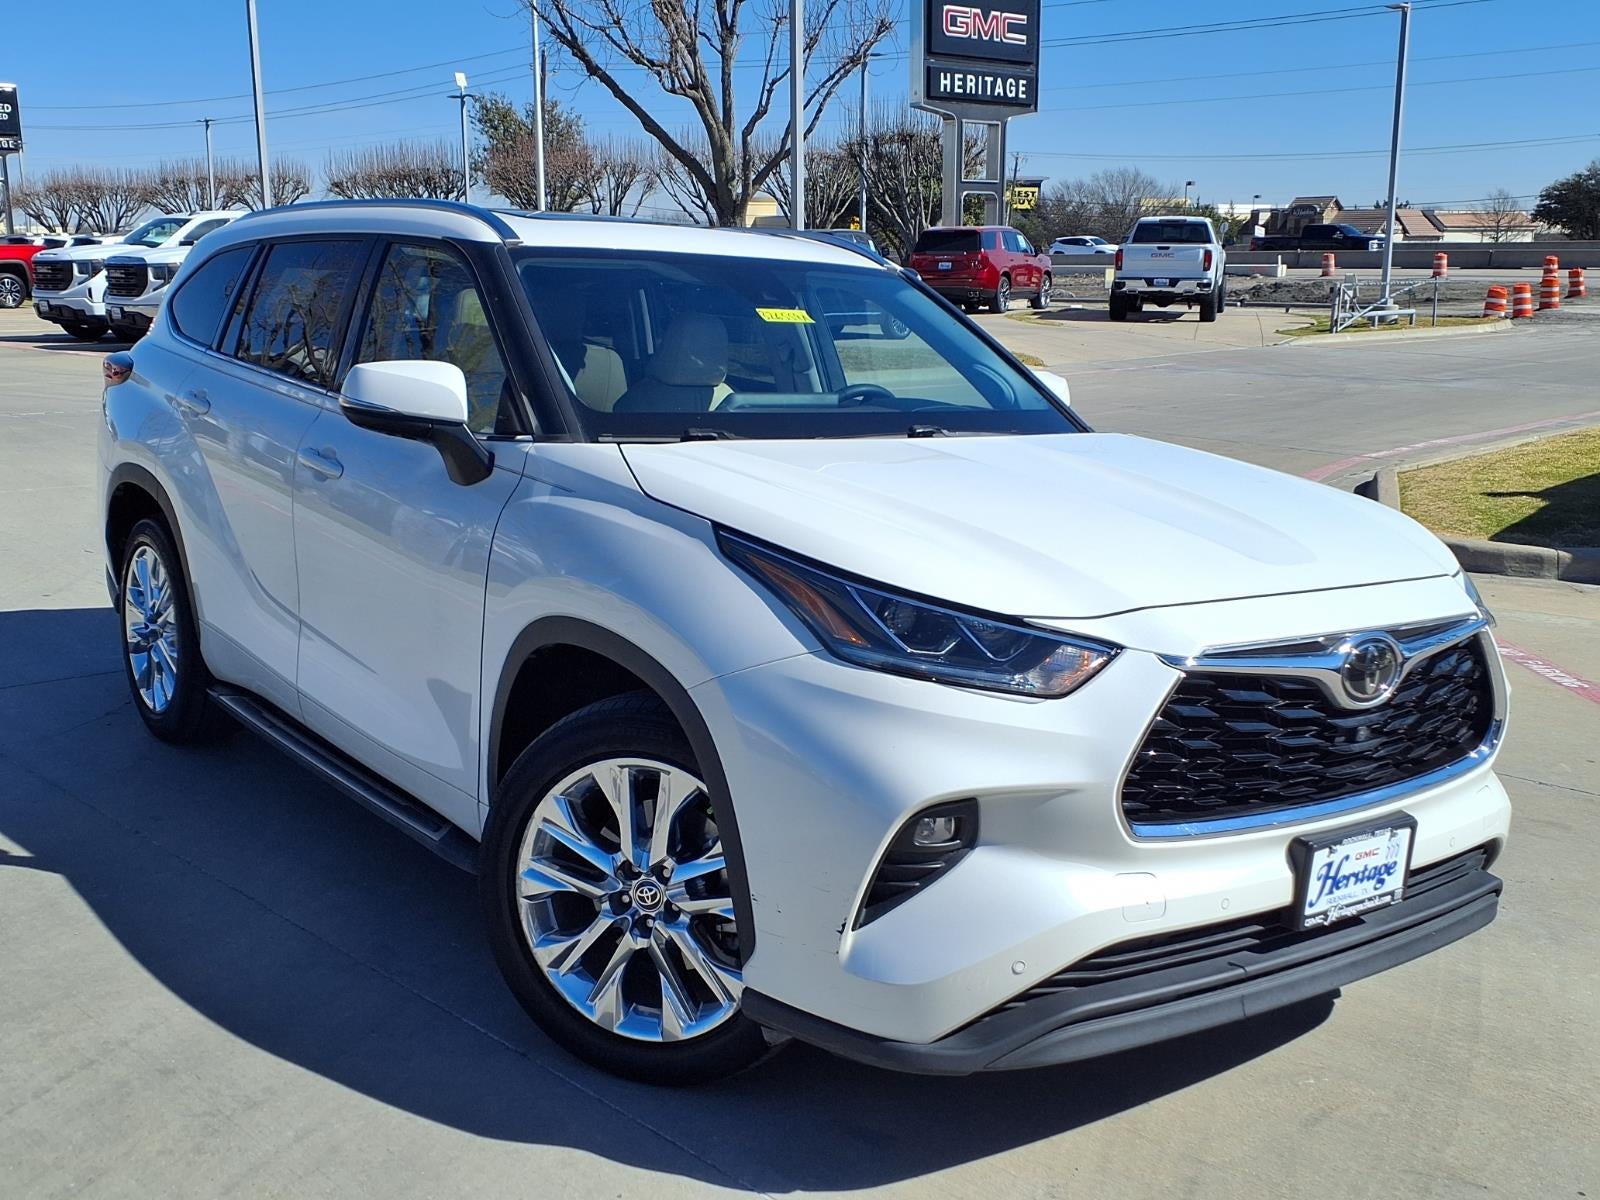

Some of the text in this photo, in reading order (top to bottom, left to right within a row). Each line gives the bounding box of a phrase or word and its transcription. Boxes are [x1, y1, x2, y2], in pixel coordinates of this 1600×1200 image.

[943, 5, 1027, 45] GMC
[940, 72, 1027, 98] HERITAGE
[1355, 847, 1381, 861] GMC
[1308, 854, 1398, 908] Heritage
